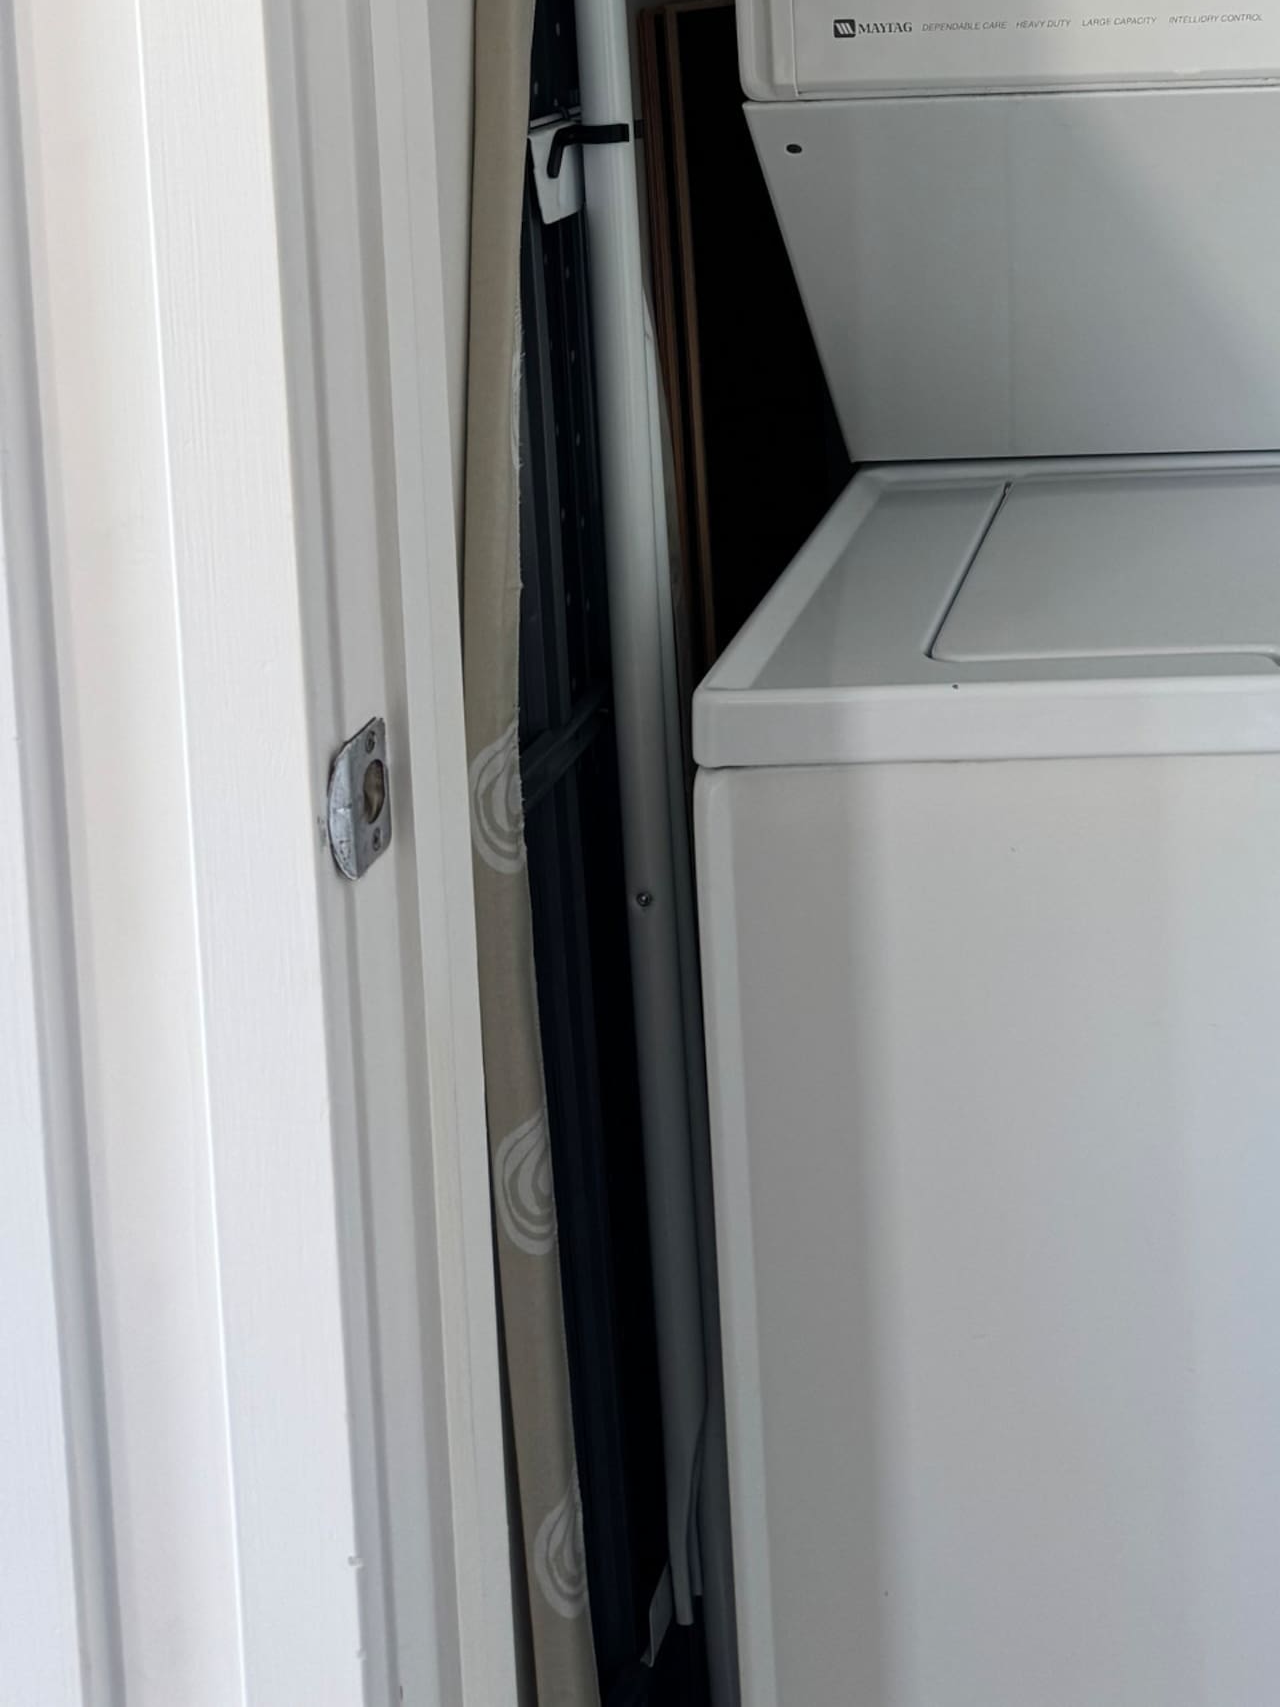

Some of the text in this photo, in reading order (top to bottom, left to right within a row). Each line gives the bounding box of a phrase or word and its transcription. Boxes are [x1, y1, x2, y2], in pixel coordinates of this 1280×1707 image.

[1081, 16, 1157, 27] LARGE CAPACITY
[1220, 13, 1263, 22] CONTROL
[858, 22, 913, 34] MAYTAG
[921, 21, 1008, 32] DEPENDABLE CARE
[1016, 19, 1071, 29] HEAVY DUTY
